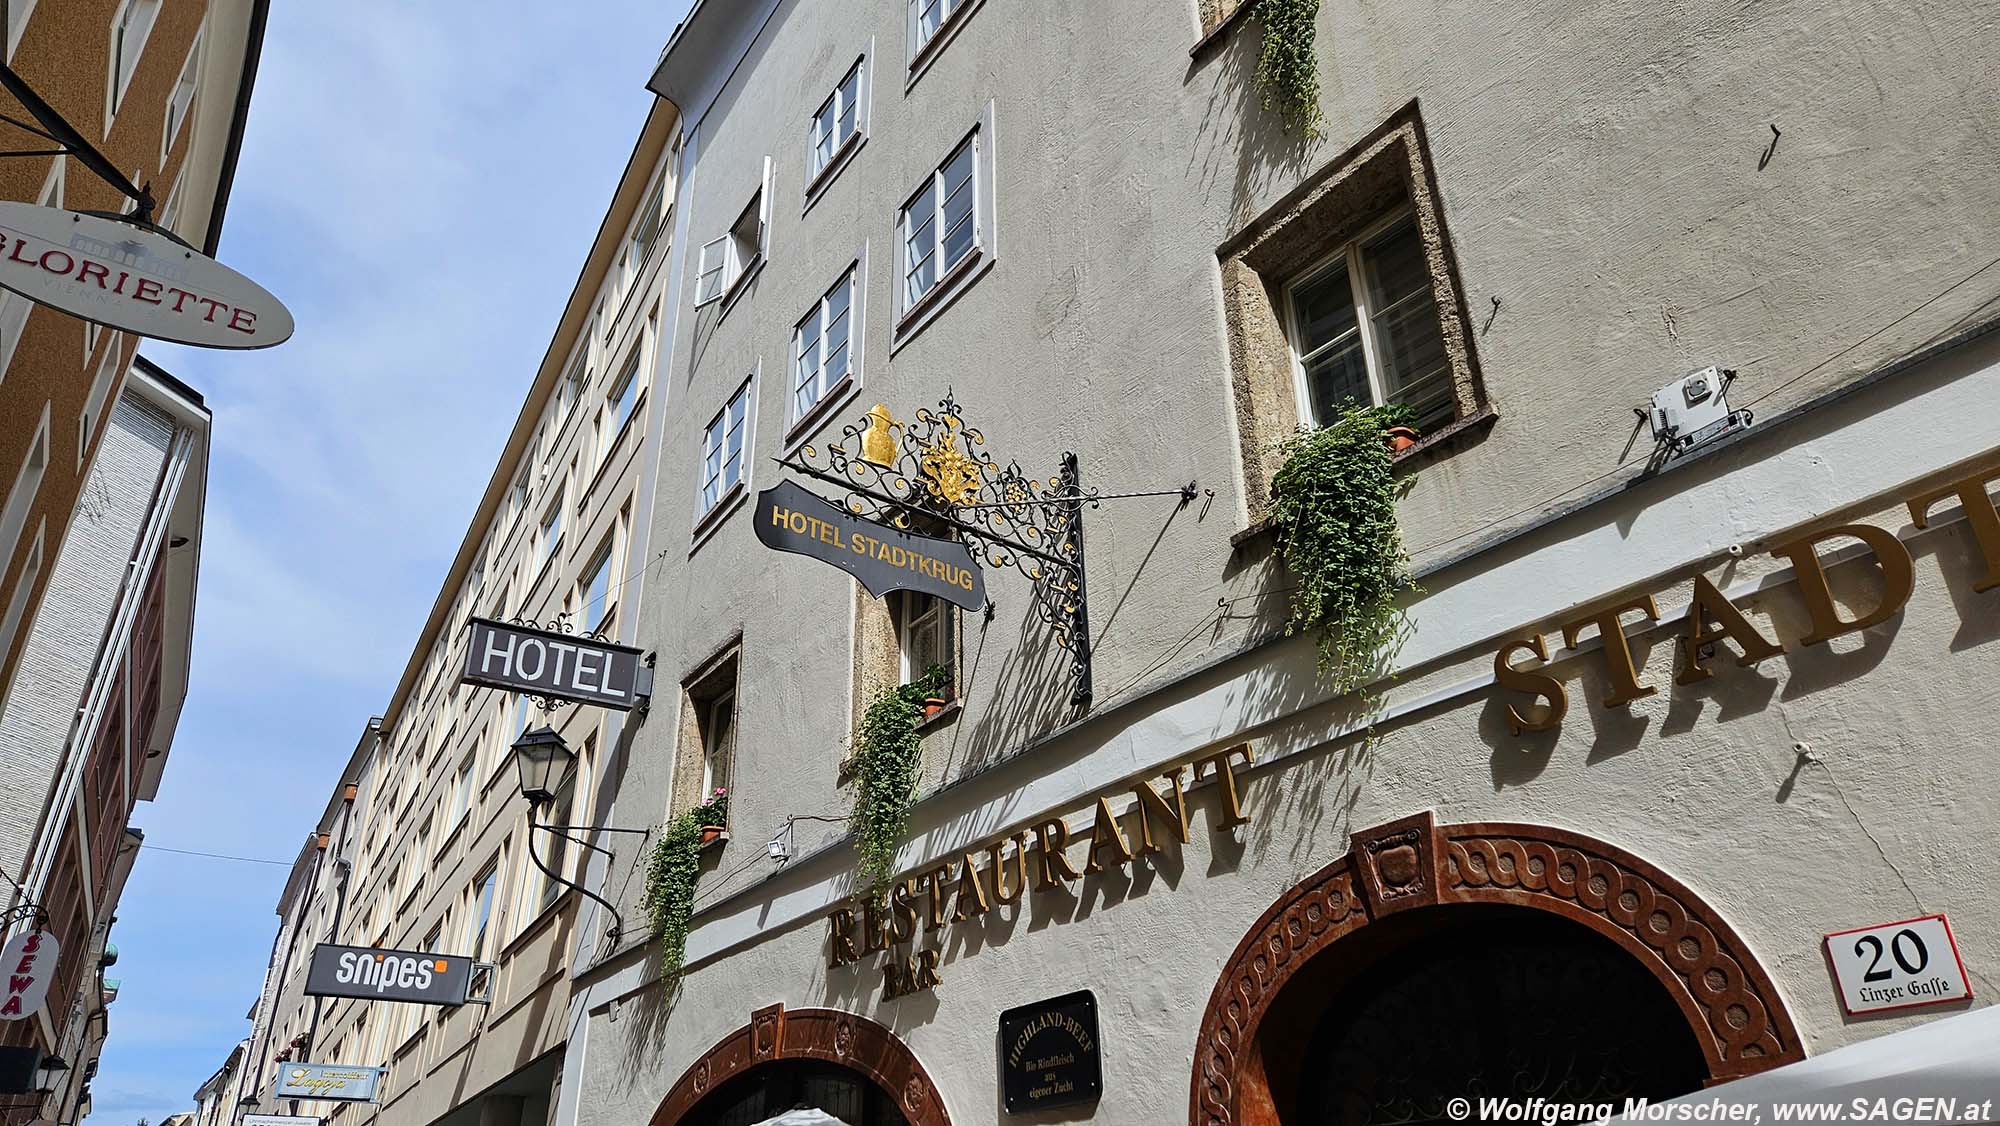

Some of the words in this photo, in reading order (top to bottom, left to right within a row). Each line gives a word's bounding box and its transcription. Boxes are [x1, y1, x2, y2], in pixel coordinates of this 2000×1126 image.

[0, 233, 257, 334] LORIETTE
[772, 505, 846, 550] HOTEL
[851, 534, 974, 591] STADTKRUG
[481, 630, 626, 698] HOTEL
[828, 741, 1256, 970] RESTAURANT
[1, 934, 43, 1016] SEWA
[336, 952, 434, 993] snipes
[881, 949, 944, 1003] BAR
[1854, 928, 1938, 983] 20
[1859, 987, 1904, 1003] Linzer
